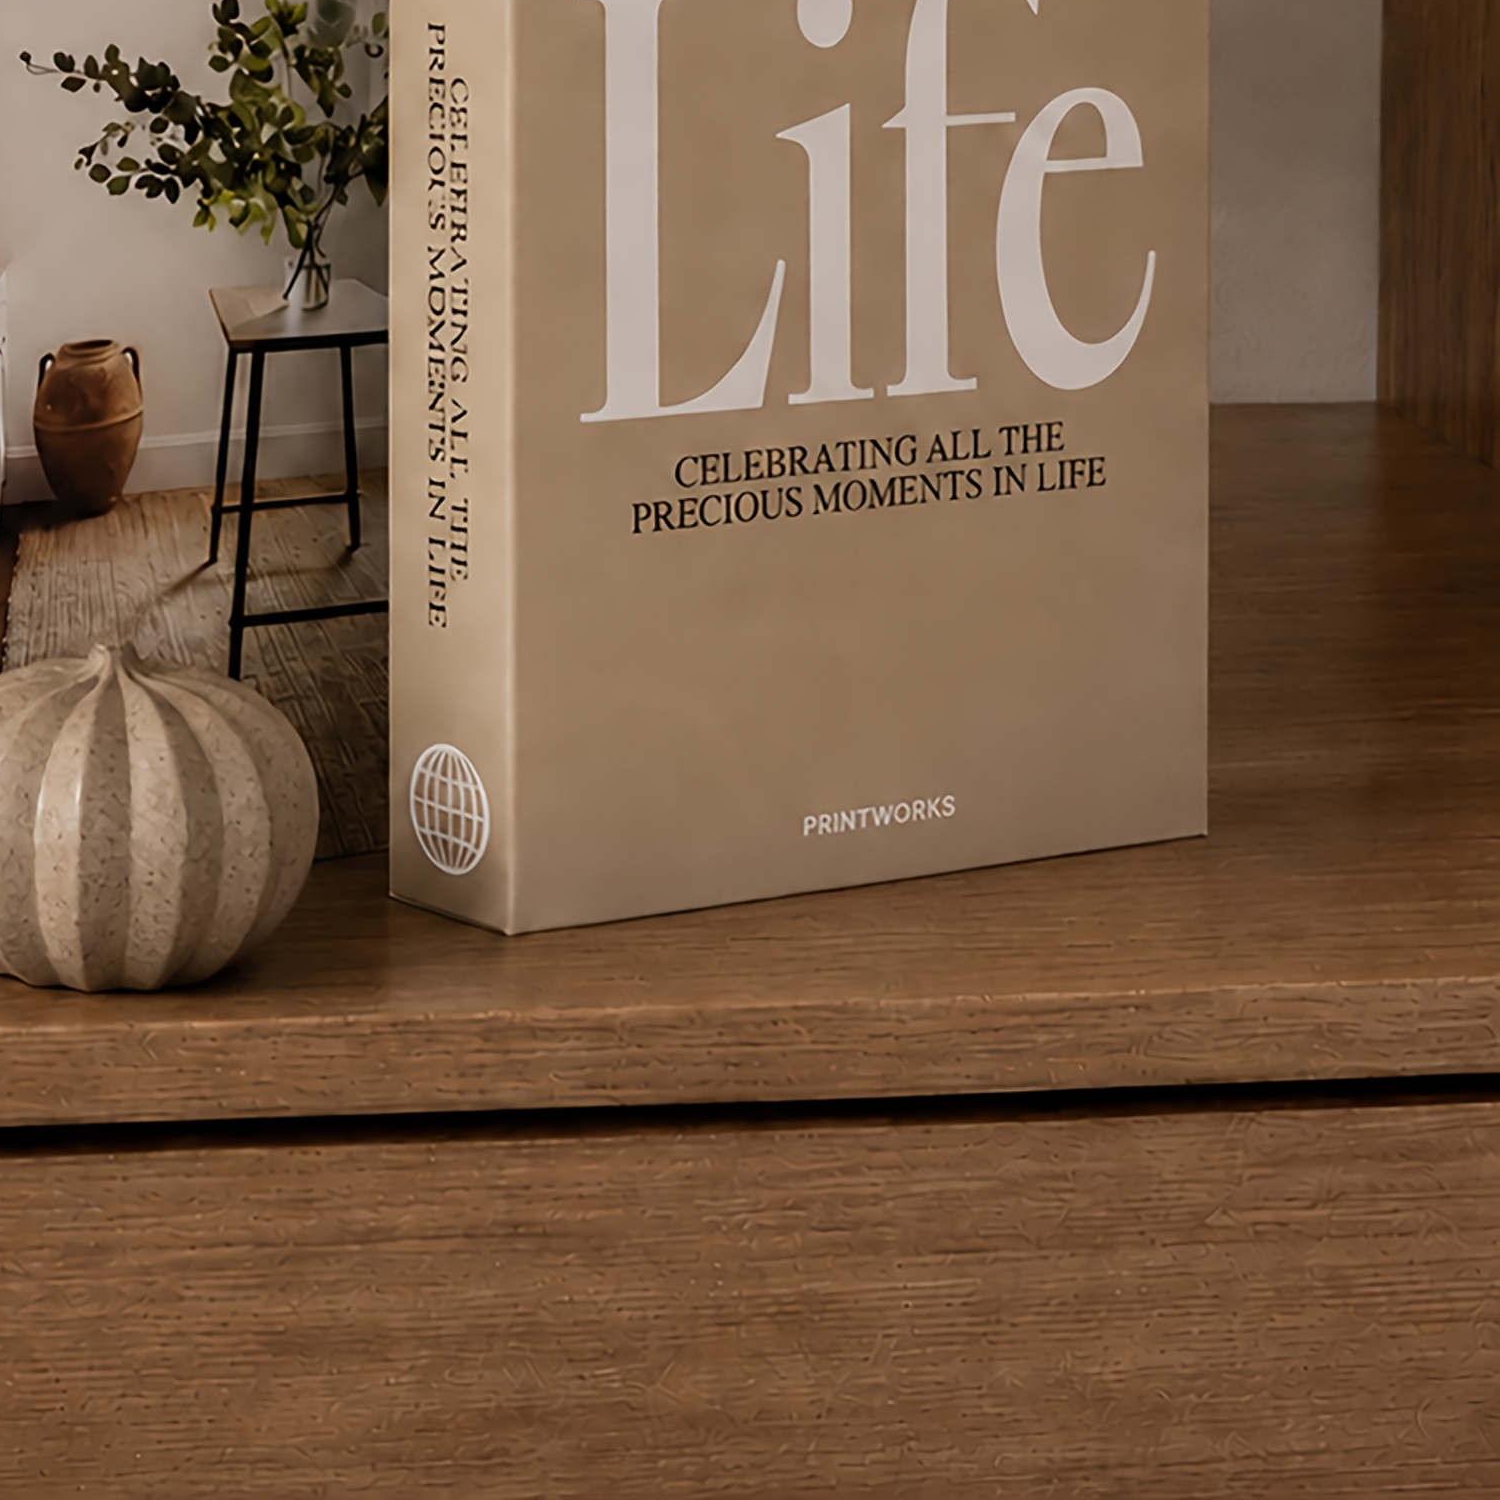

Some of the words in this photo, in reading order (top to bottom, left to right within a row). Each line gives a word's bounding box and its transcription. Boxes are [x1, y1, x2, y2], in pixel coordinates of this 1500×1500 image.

[674, 434, 917, 489] CELEBRATING
[926, 429, 991, 464] ALL
[999, 421, 1065, 456] THE
[428, 477, 446, 520] IN
[632, 486, 803, 534] PRECIOUS
[812, 468, 983, 515] MOMENTS
[993, 463, 1027, 496] IN
[1037, 456, 1107, 493] LIFE
[803, 795, 956, 836] PRINTWORKS
